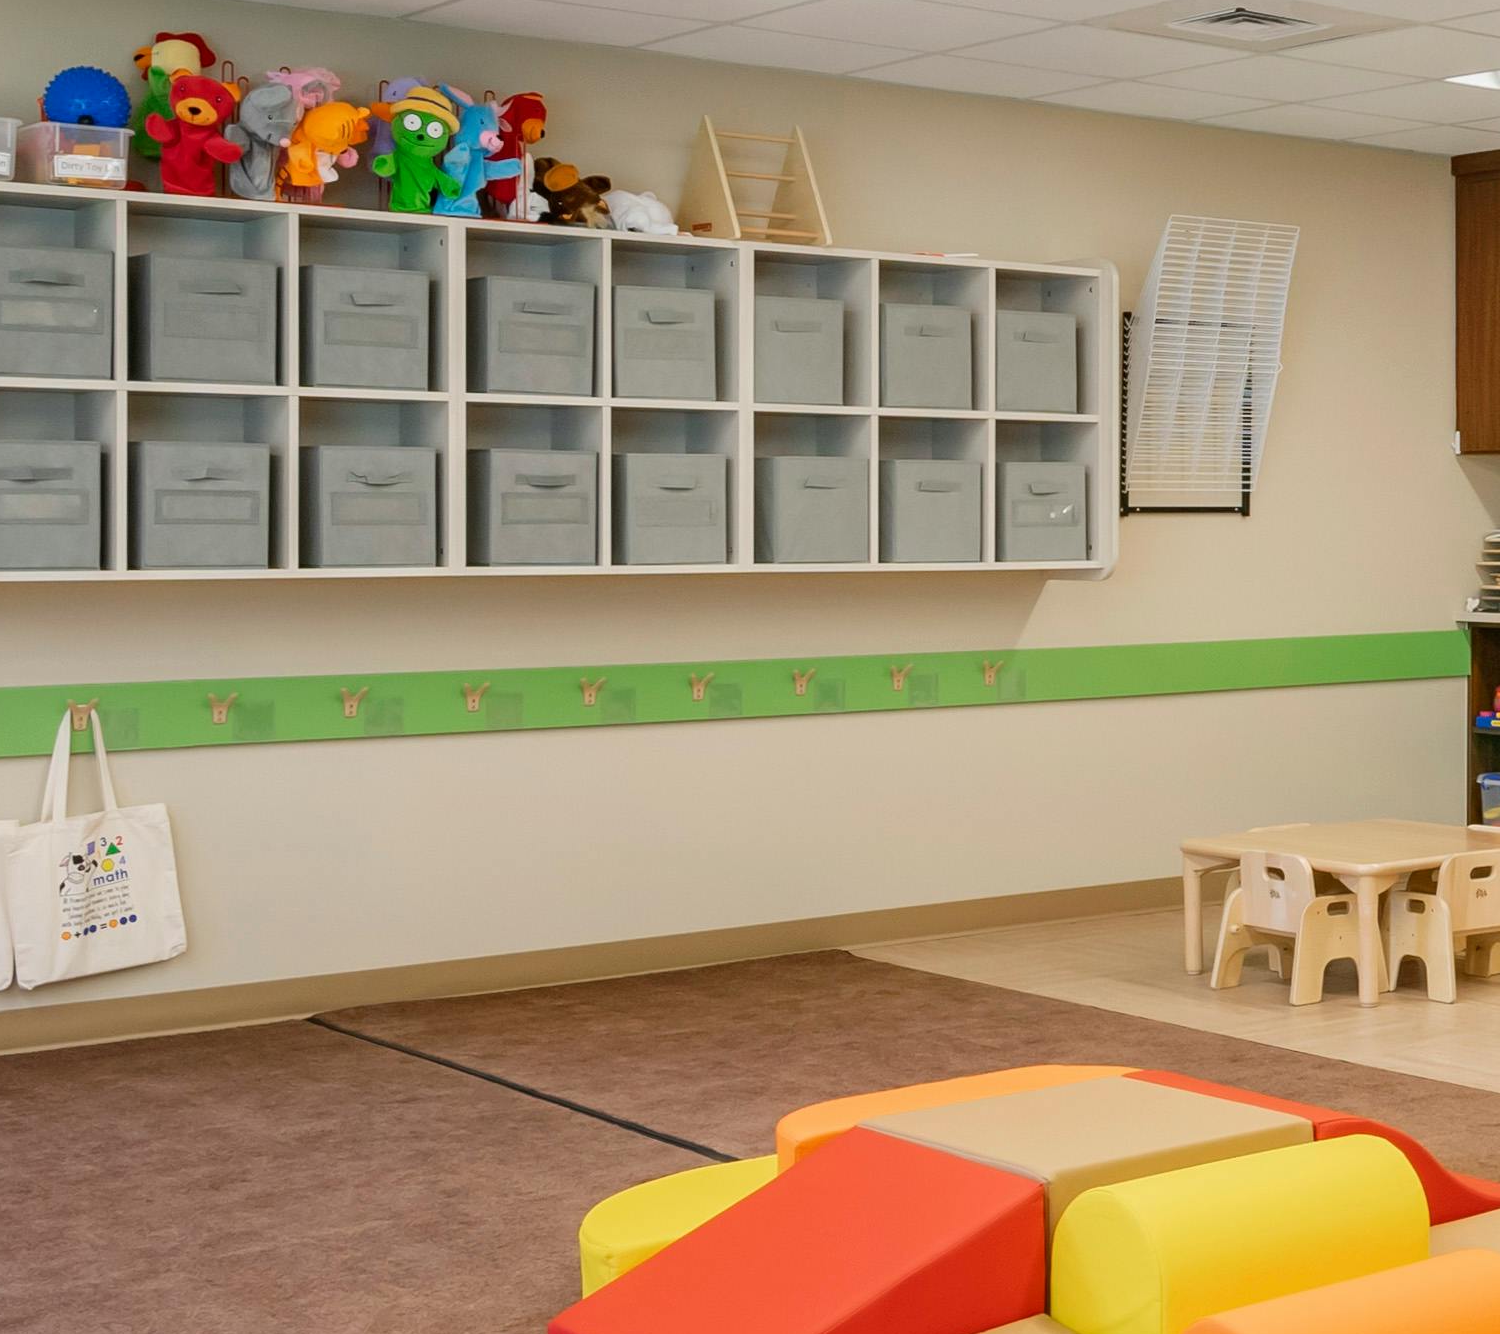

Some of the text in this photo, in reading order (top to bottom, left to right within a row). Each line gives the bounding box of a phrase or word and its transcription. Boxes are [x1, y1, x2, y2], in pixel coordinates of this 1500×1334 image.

[60, 161, 84, 172] Dirty
[100, 836, 123, 847] 3 2
[93, 868, 128, 886] math
